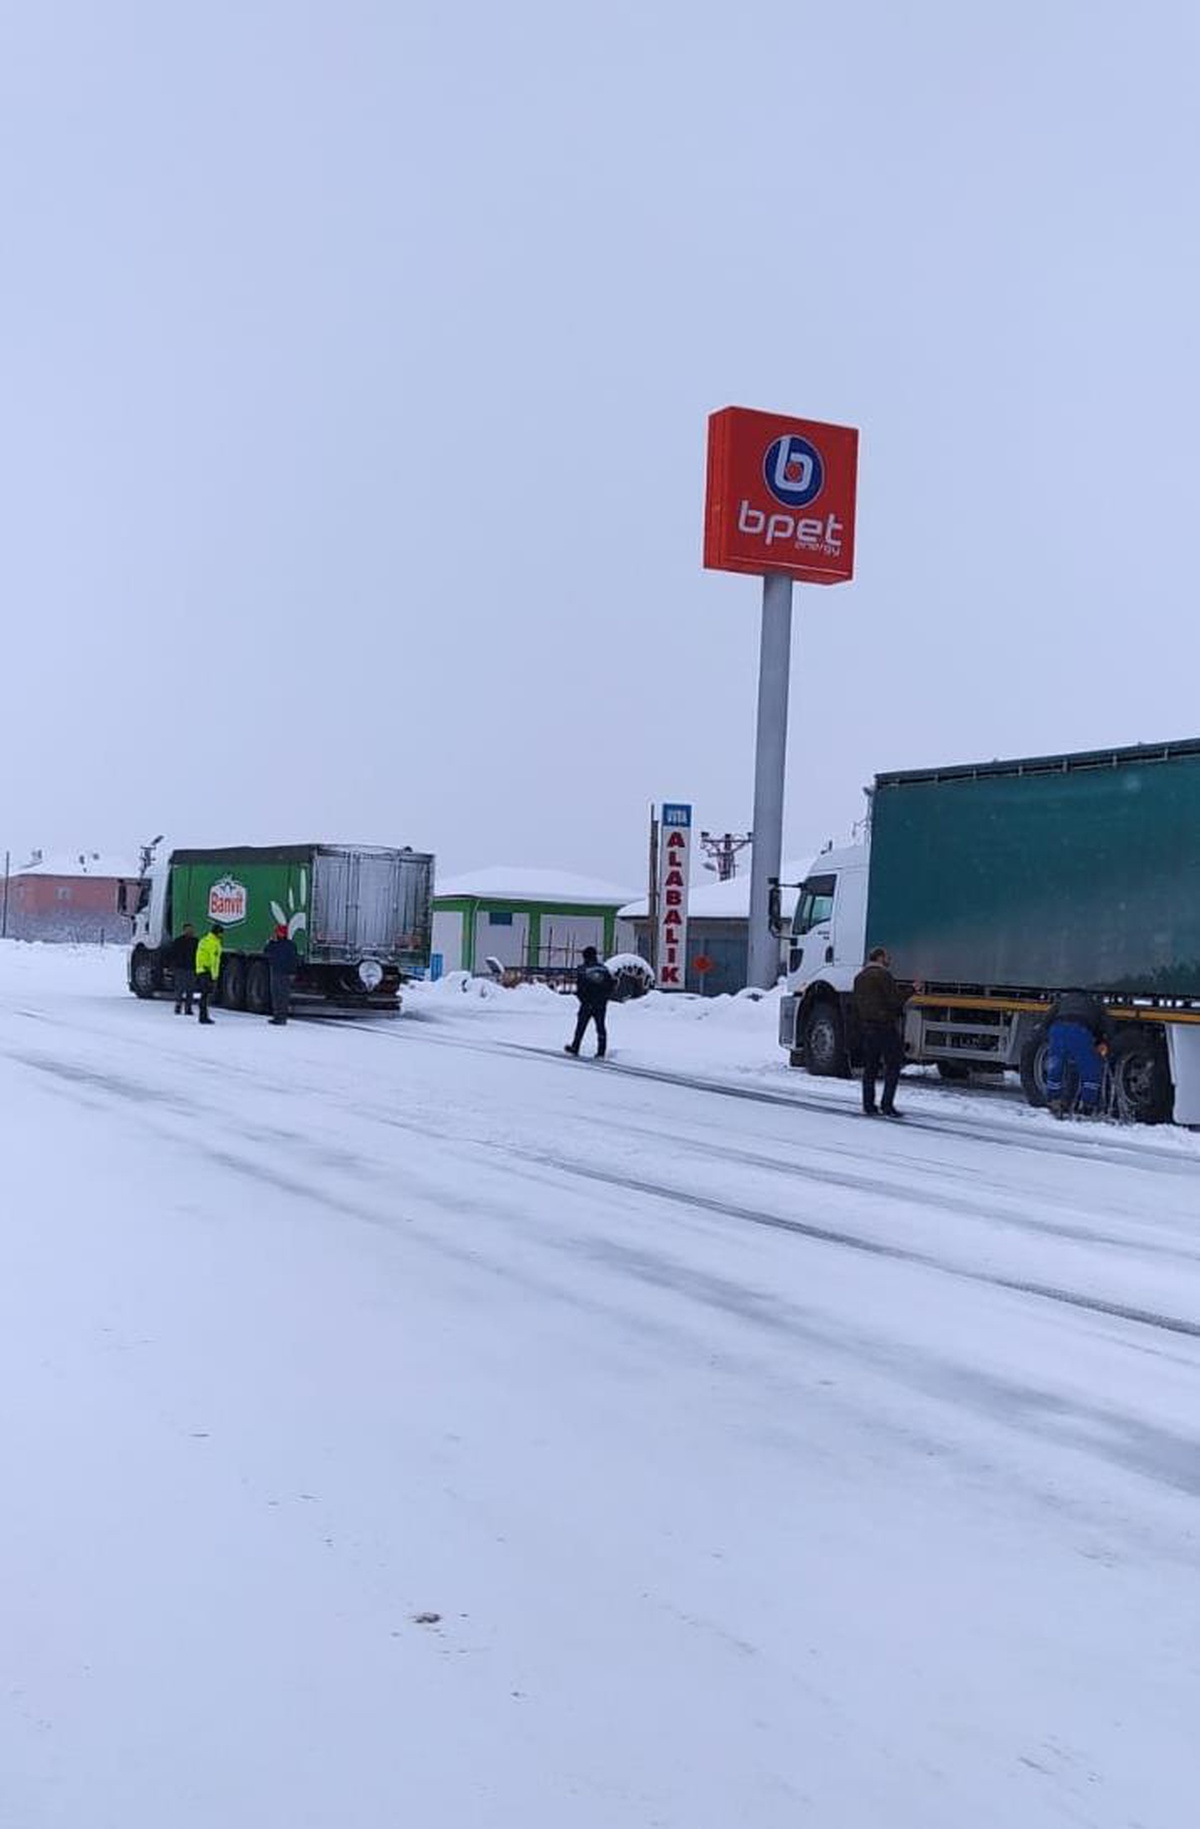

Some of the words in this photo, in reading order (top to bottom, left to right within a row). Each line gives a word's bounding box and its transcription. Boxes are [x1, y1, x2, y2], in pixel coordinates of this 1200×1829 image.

[738, 500, 844, 546] bpet
[211, 890, 243, 915] Banvit
[661, 831, 685, 983] ALABALIK
